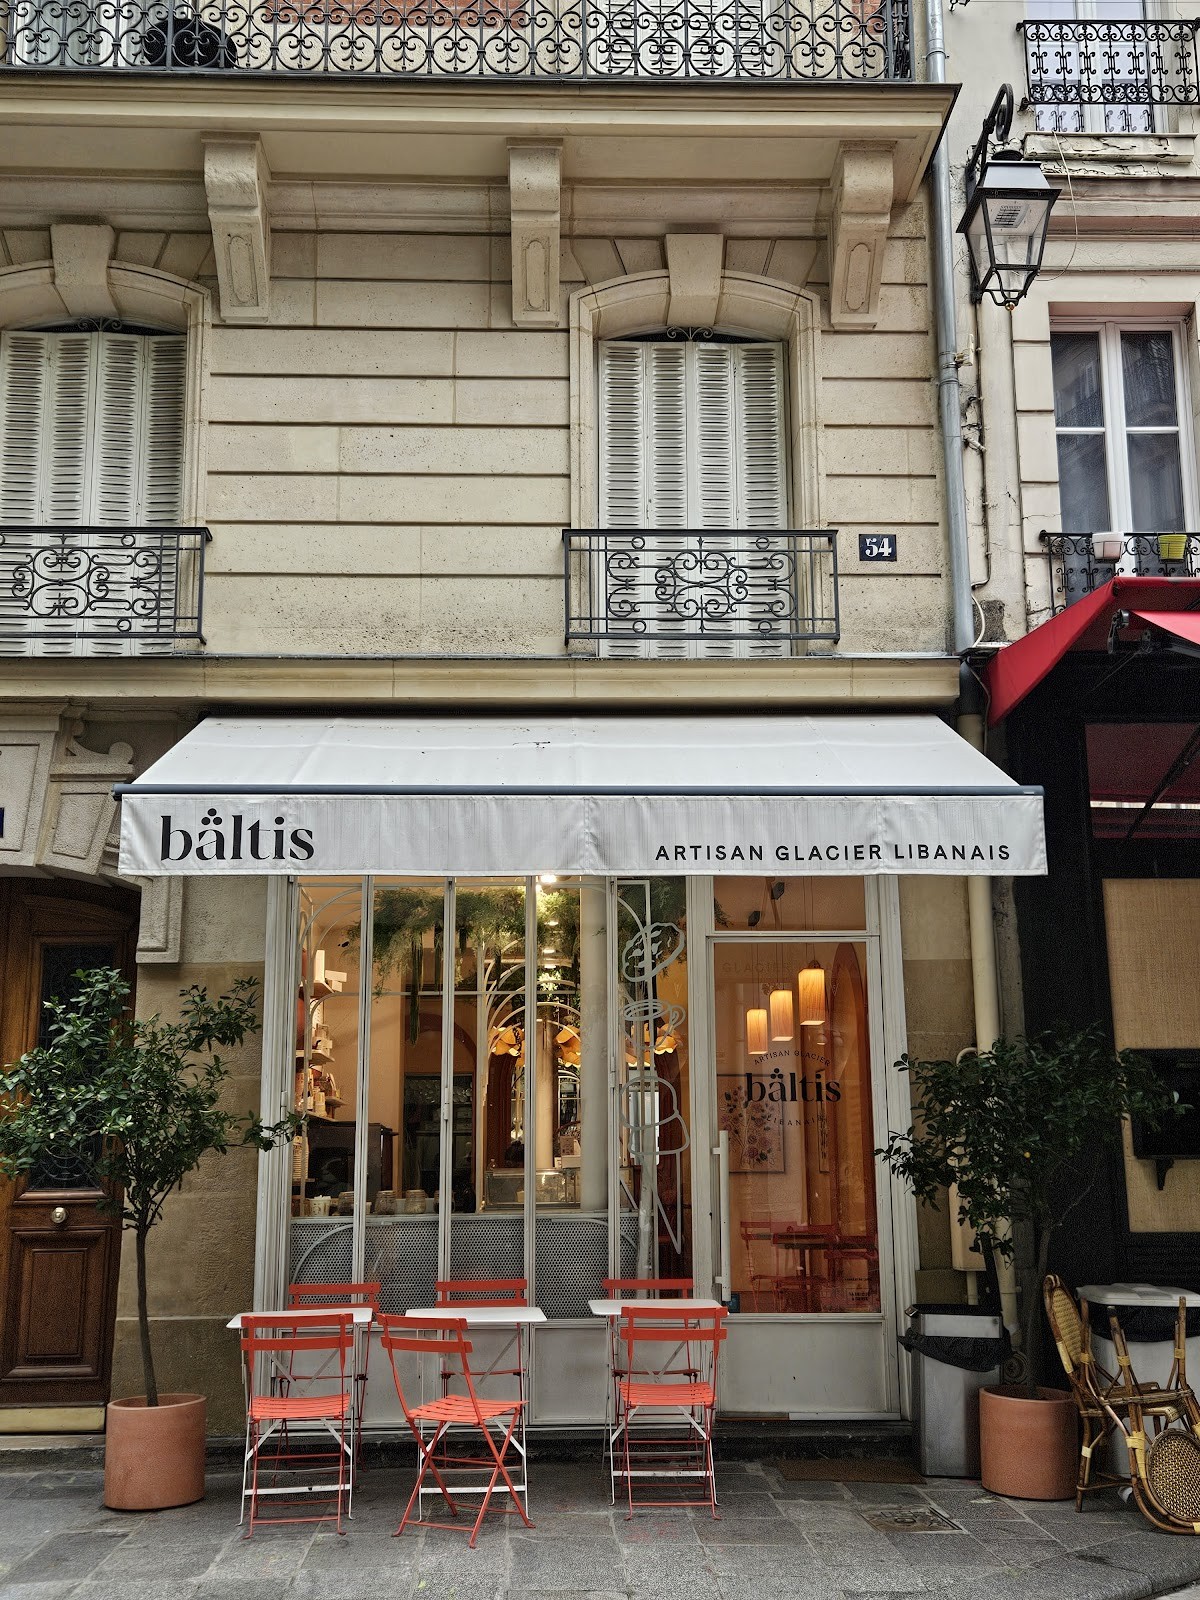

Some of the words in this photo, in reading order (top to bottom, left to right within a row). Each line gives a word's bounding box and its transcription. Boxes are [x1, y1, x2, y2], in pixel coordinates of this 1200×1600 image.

[865, 537, 892, 557] 54
[656, 846, 762, 860] ARTISAN
[776, 845, 881, 860] GLACIER
[895, 844, 1009, 860] LIBANAIS
[754, 1050, 790, 1066] ARTISAN
[794, 1050, 831, 1067] GLACIER
